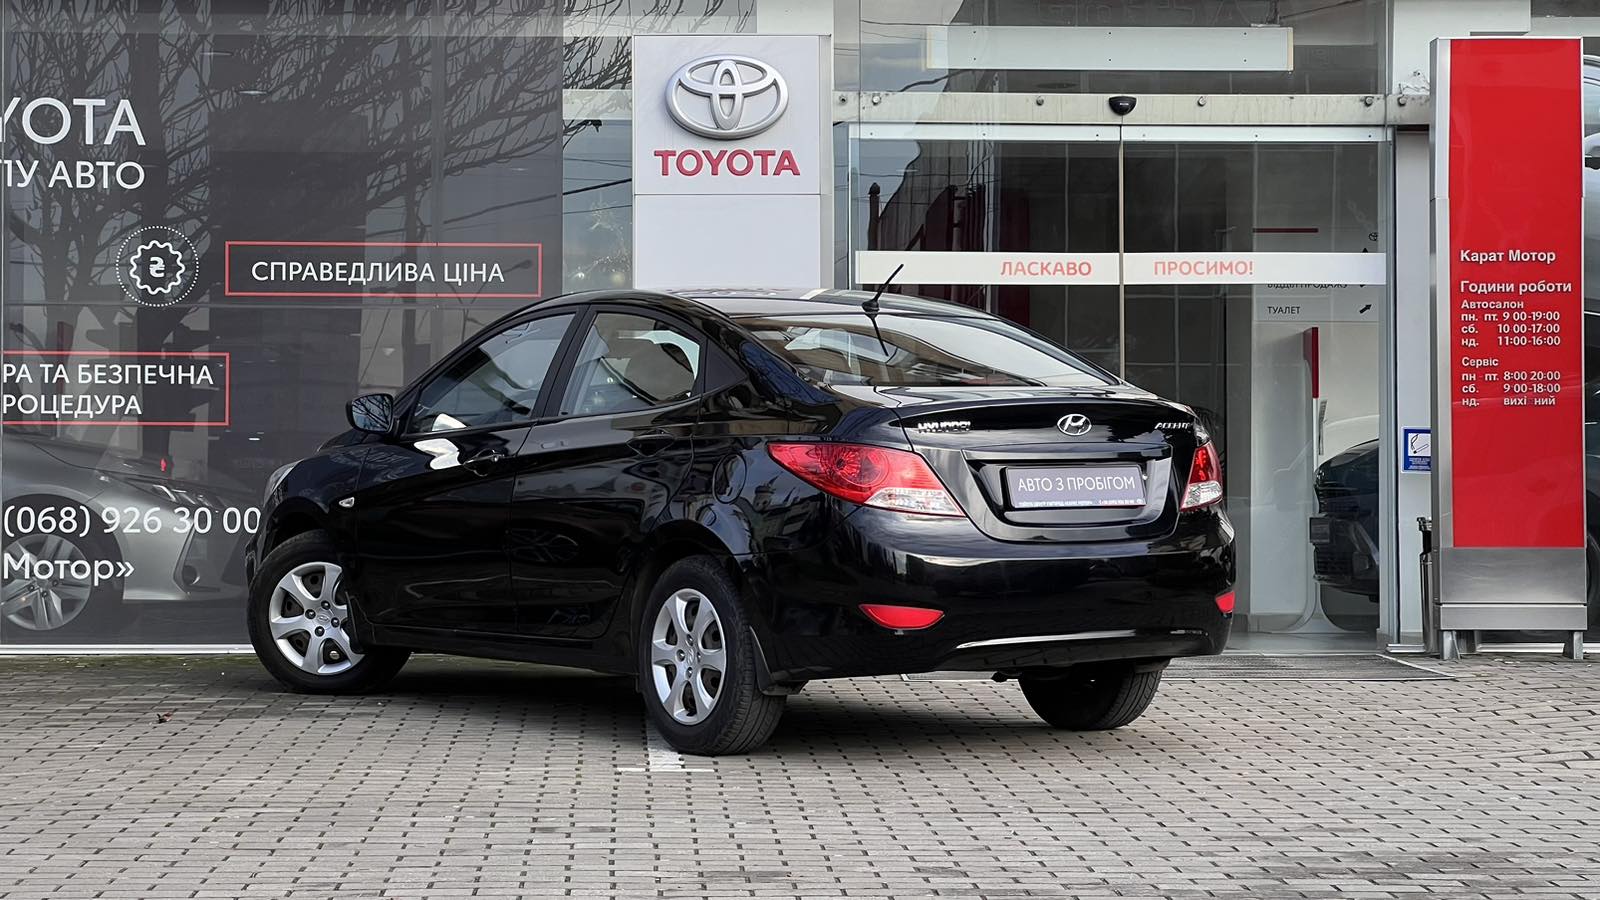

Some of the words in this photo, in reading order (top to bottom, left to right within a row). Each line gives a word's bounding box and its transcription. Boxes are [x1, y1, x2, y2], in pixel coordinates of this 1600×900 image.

[654, 149, 801, 176] TOYOTA
[48, 160, 145, 190] АВТО
[1460, 250, 1504, 264] Карат
[1508, 250, 1556, 264] Мотор
[251, 261, 435, 286] СПРАВЕДЛИВА
[444, 262, 505, 286] ЦІНА
[1000, 261, 1092, 276] ЛАСКАВО
[1153, 260, 1253, 275] ПРОСИМО!
[1460, 281, 1514, 294] Години
[1519, 280, 1572, 294] роботи
[1267, 306, 1301, 315] ТУАЛЕТ
[1461, 299, 1524, 309] Автосалон
[1461, 357, 1499, 368] Сервіс
[40, 364, 70, 384] ТА
[78, 364, 214, 385] БЕЗПЕЧНА
[1018, 478, 1053, 491] АВТО
[1067, 476, 1136, 491] ПРОБІГОМ
[3, 505, 91, 538] (068)
[103, 506, 162, 533] 926
[173, 506, 212, 533] 30
[222, 506, 262, 534] 00
[3, 552, 135, 587] Мотор»
